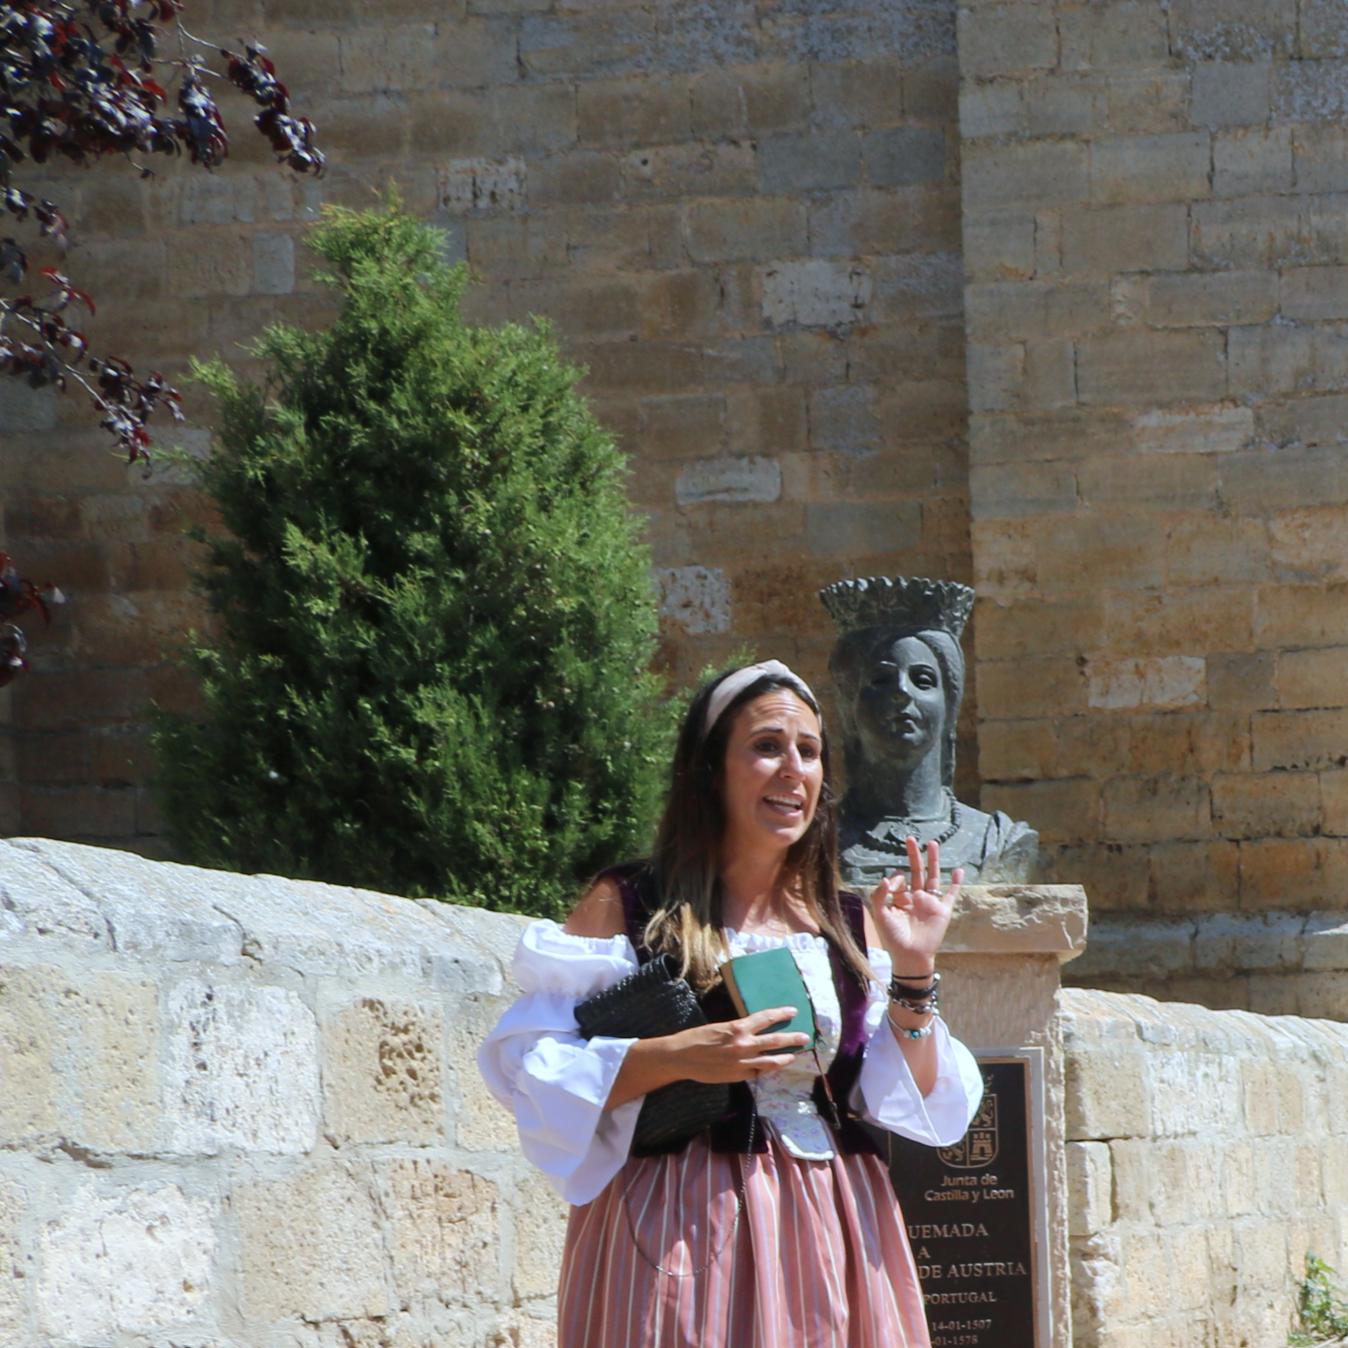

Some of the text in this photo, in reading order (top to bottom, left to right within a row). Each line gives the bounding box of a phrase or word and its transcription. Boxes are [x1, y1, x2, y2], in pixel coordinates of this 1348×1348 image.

[940, 1173, 998, 1187] Junta de
[924, 1189, 970, 1201] Castilla
[972, 1190, 980, 1203] y
[918, 1262, 1027, 1279] DE AUSTRIA
[924, 1292, 998, 1304] PORTUGAL
